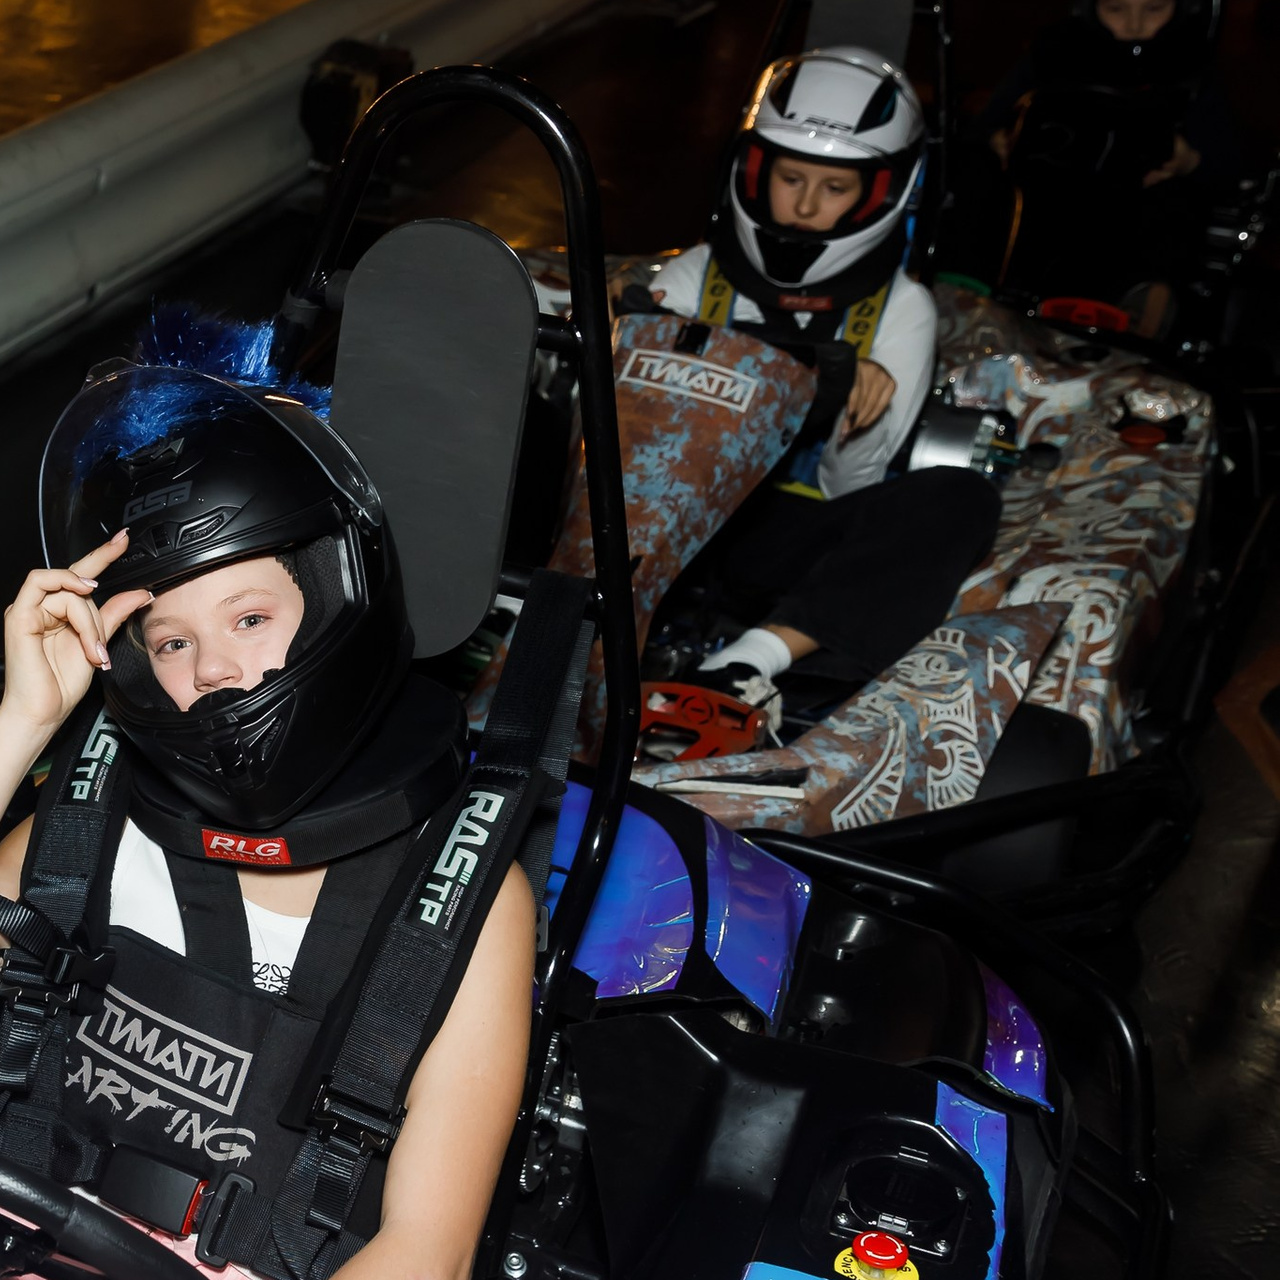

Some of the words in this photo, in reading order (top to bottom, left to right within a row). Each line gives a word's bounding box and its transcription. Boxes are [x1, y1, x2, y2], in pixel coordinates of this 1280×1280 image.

[210, 835, 281, 857] RLG
[419, 791, 505, 925] RASTP
[65, 1056, 257, 1168] ARTING
